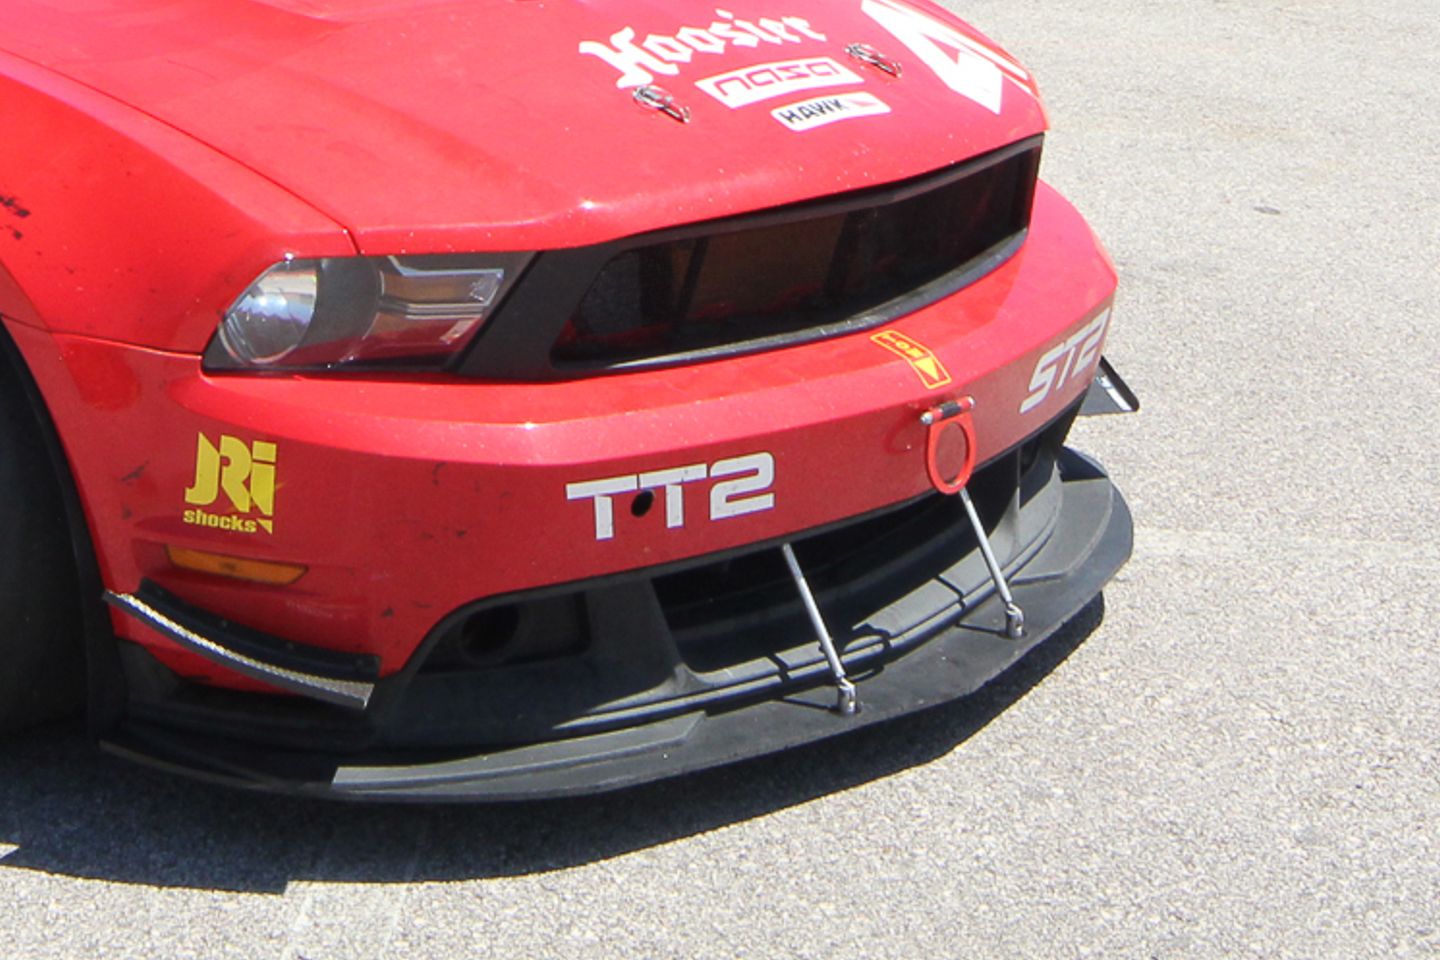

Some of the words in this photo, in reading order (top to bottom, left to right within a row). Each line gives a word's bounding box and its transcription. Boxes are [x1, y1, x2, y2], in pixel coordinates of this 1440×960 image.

[579, 9, 827, 88] Hoosier
[779, 98, 848, 123] HAWK
[1018, 308, 1110, 415] ST2
[183, 509, 258, 533] shocks
[566, 452, 775, 541] TT2
